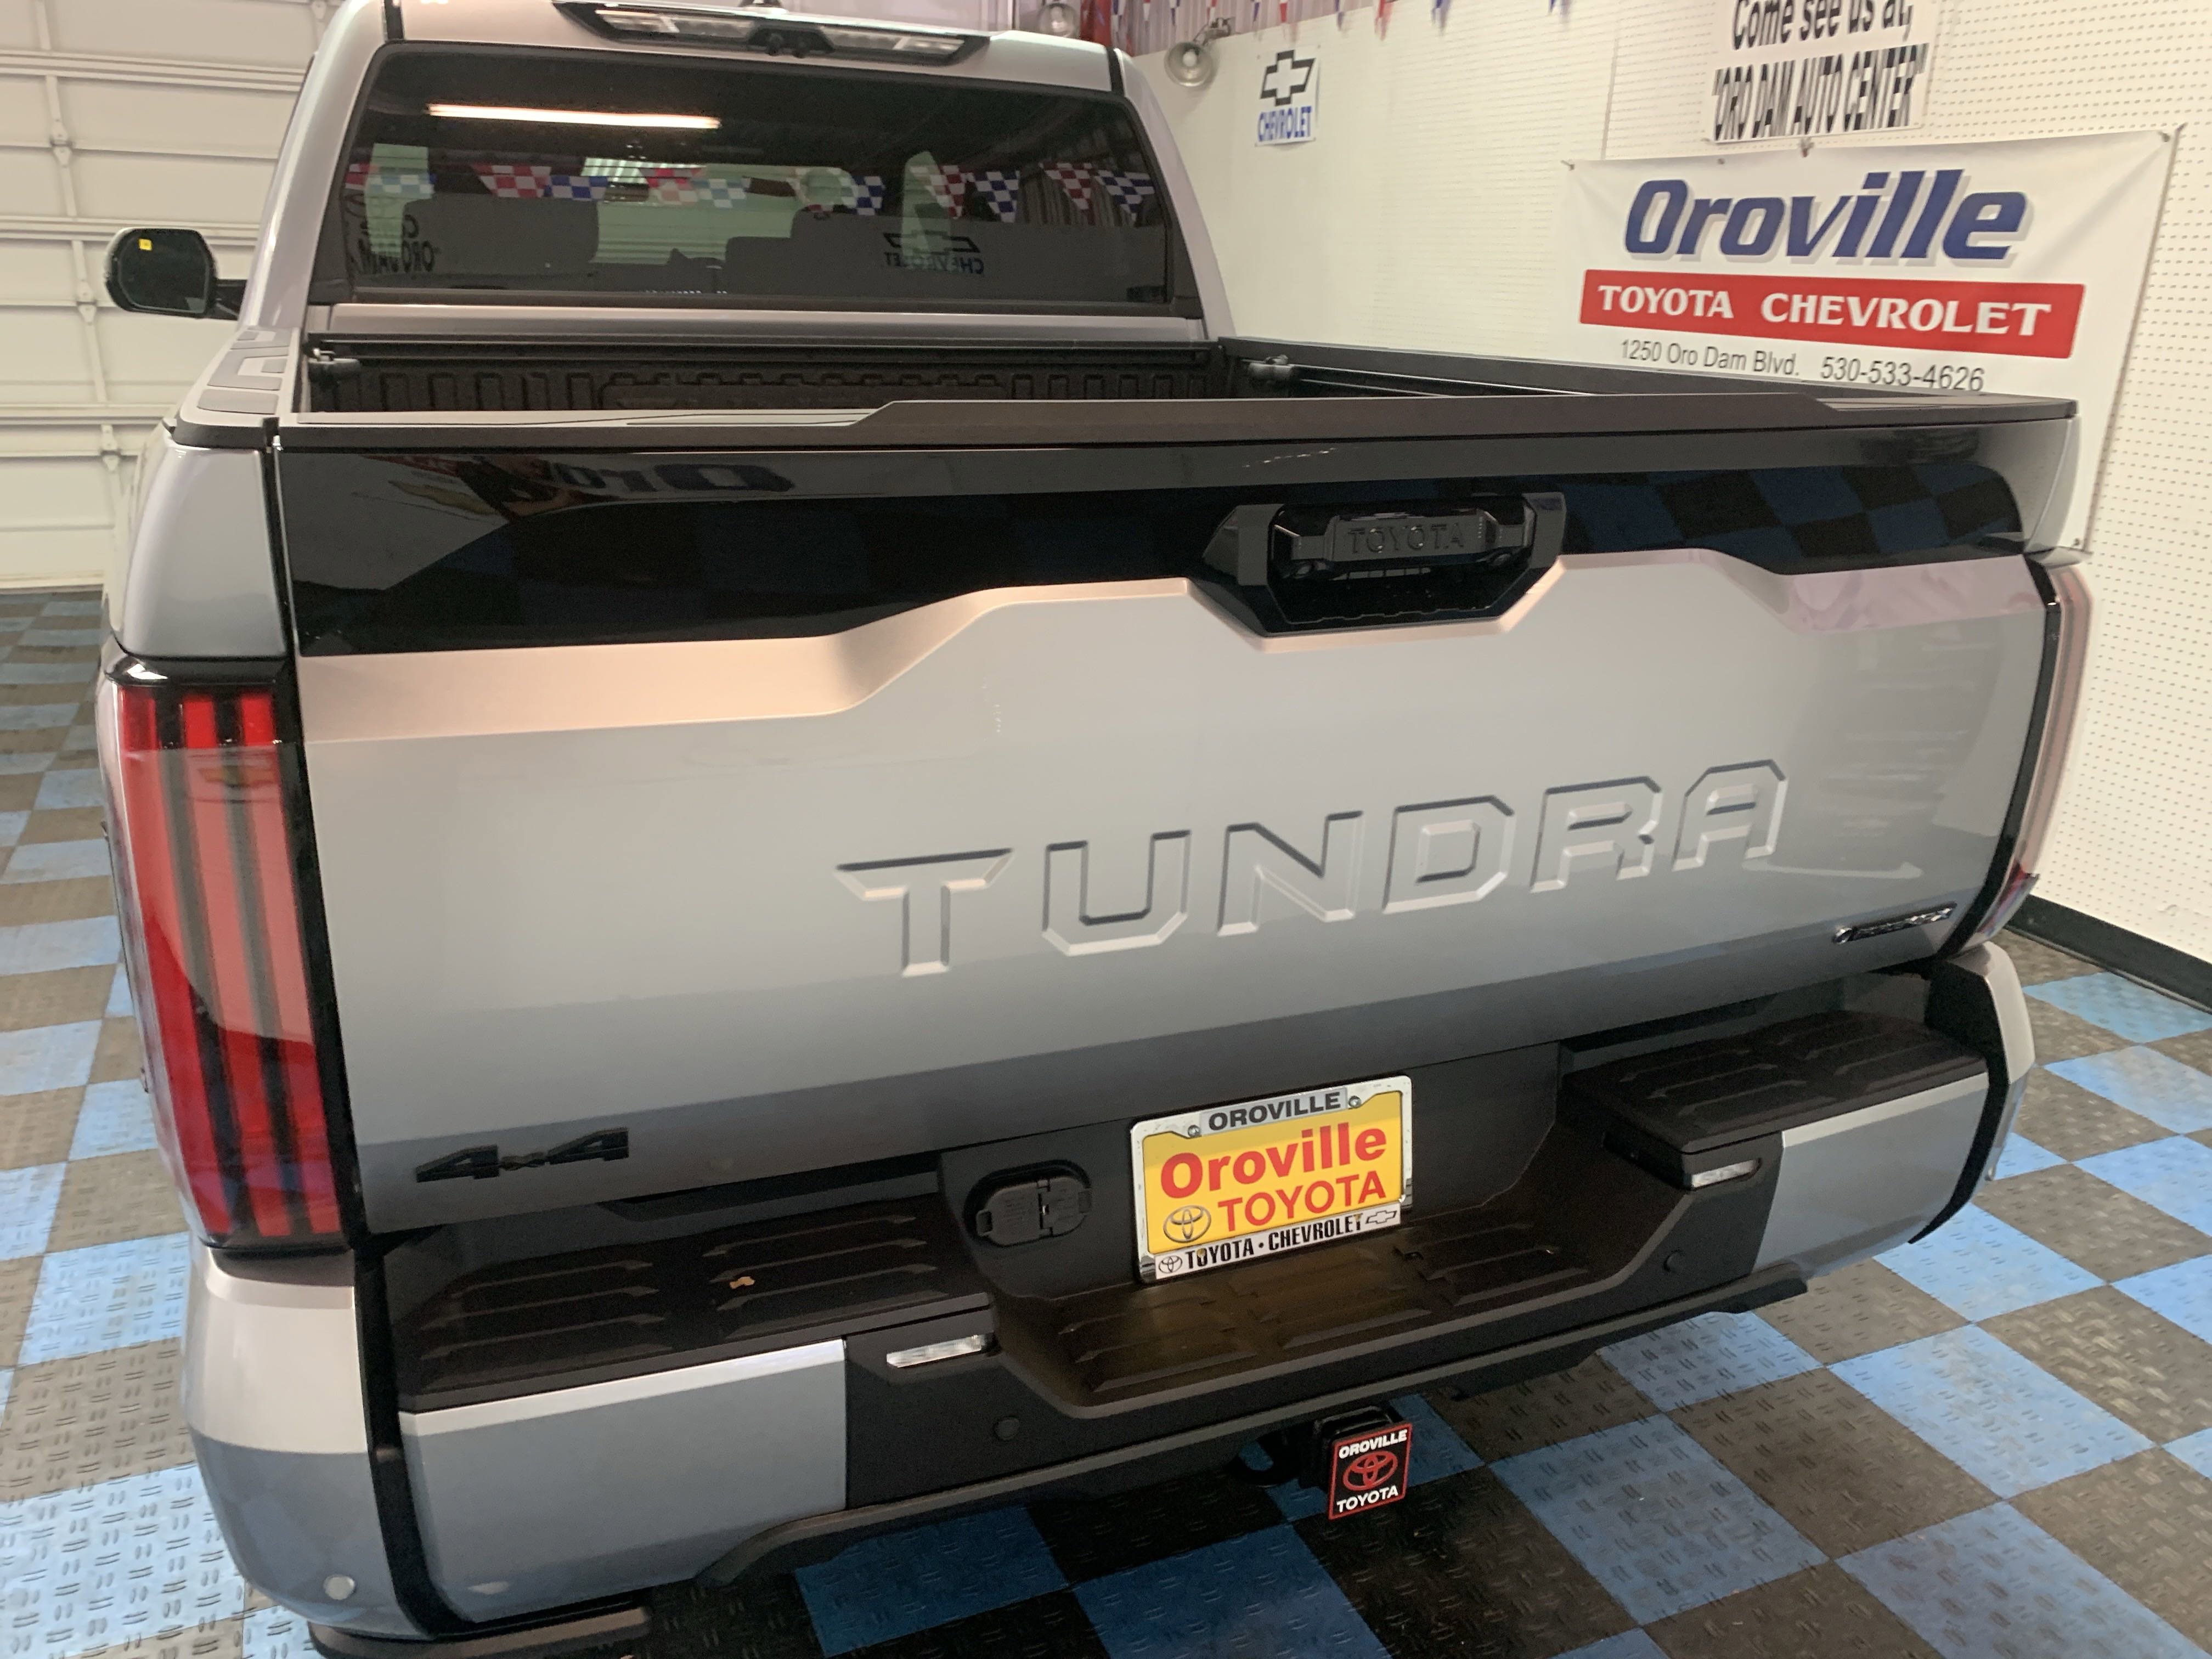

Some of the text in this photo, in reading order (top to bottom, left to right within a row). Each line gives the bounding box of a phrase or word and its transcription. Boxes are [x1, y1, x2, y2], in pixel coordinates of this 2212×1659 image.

[1733, 0, 1795, 50] Come
[1800, 0, 1842, 41] see
[1848, 0, 1874, 34] us
[1752, 59, 1796, 138] DAM
[1791, 54, 1843, 135] AUTO
[1258, 106, 1312, 142] CHEVROLET
[1624, 169, 2029, 261] Oroville
[1597, 285, 2052, 336] TOYOTA CHEVROLET
[1621, 338, 1986, 393] 1250 Oro Dam Blvd. 530-533-4626
[1347, 522, 1465, 554] TOYOTA
[835, 759, 1789, 977] TUNDRA
[1208, 1092, 1341, 1131] OROVILLE
[1160, 1122, 1387, 1199] Oroville
[1217, 1170, 1387, 1232] TOYOTA
[1185, 1214, 1363, 1269] TOYOTA CHEVROLET
[1339, 1429, 1408, 1459] OROVILLE
[1336, 1485, 1399, 1513] TOYOTA
